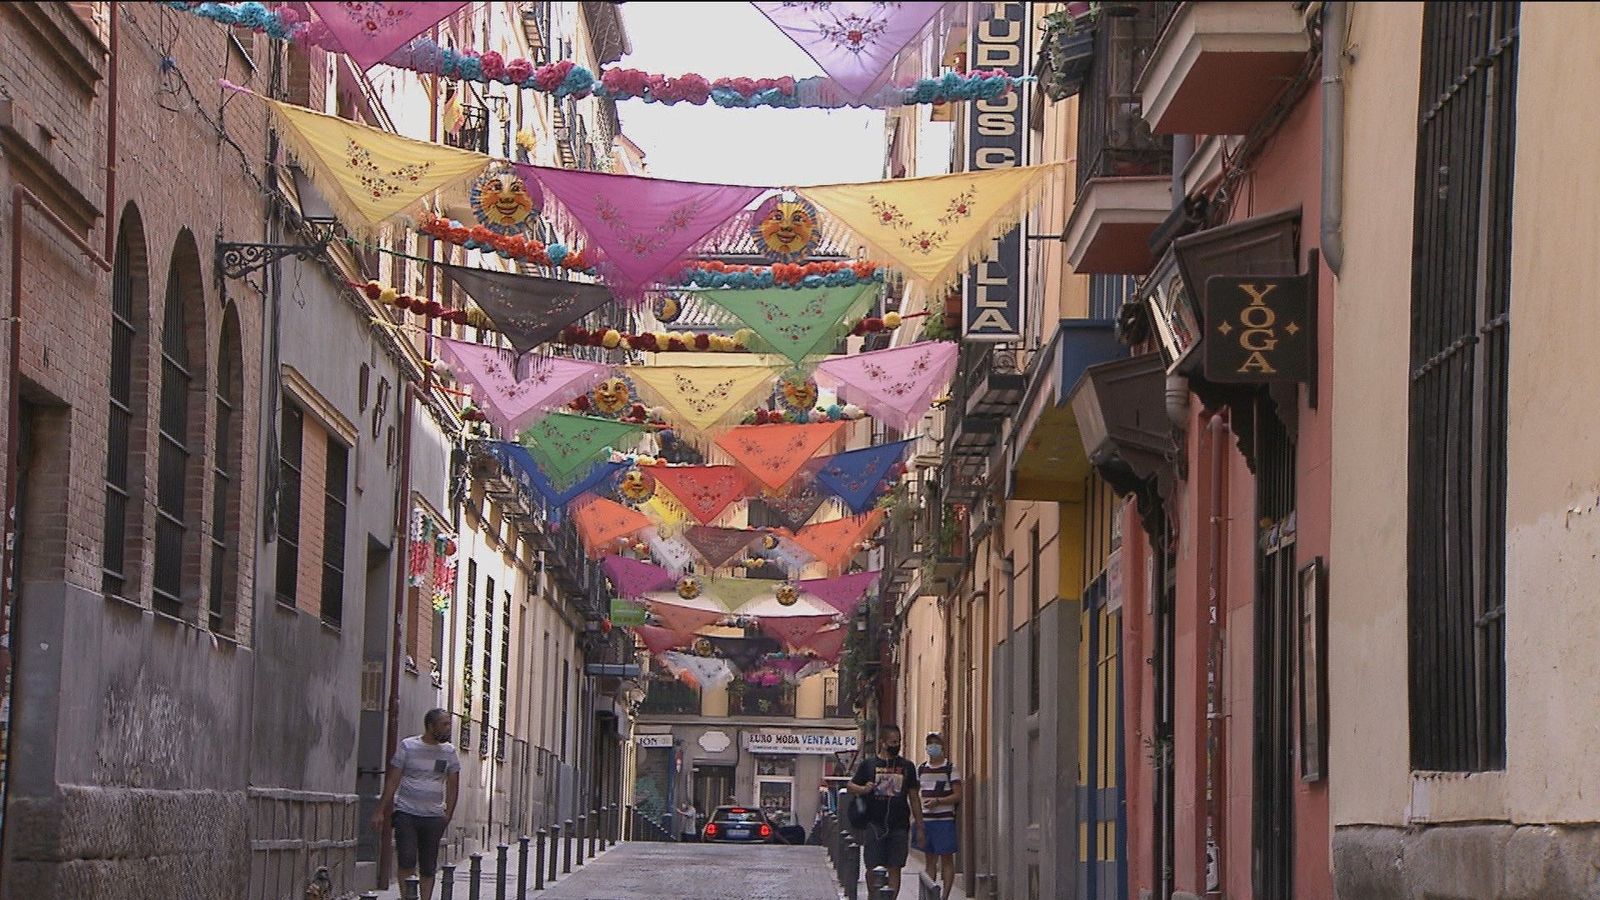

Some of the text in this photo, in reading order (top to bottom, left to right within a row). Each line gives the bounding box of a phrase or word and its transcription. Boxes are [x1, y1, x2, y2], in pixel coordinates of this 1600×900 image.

[1236, 284, 1279, 374] YOGA
[749, 734, 773, 743] EURO
[776, 735, 800, 744] MODA
[802, 735, 830, 745] VENTA
[832, 736, 843, 746] AL
